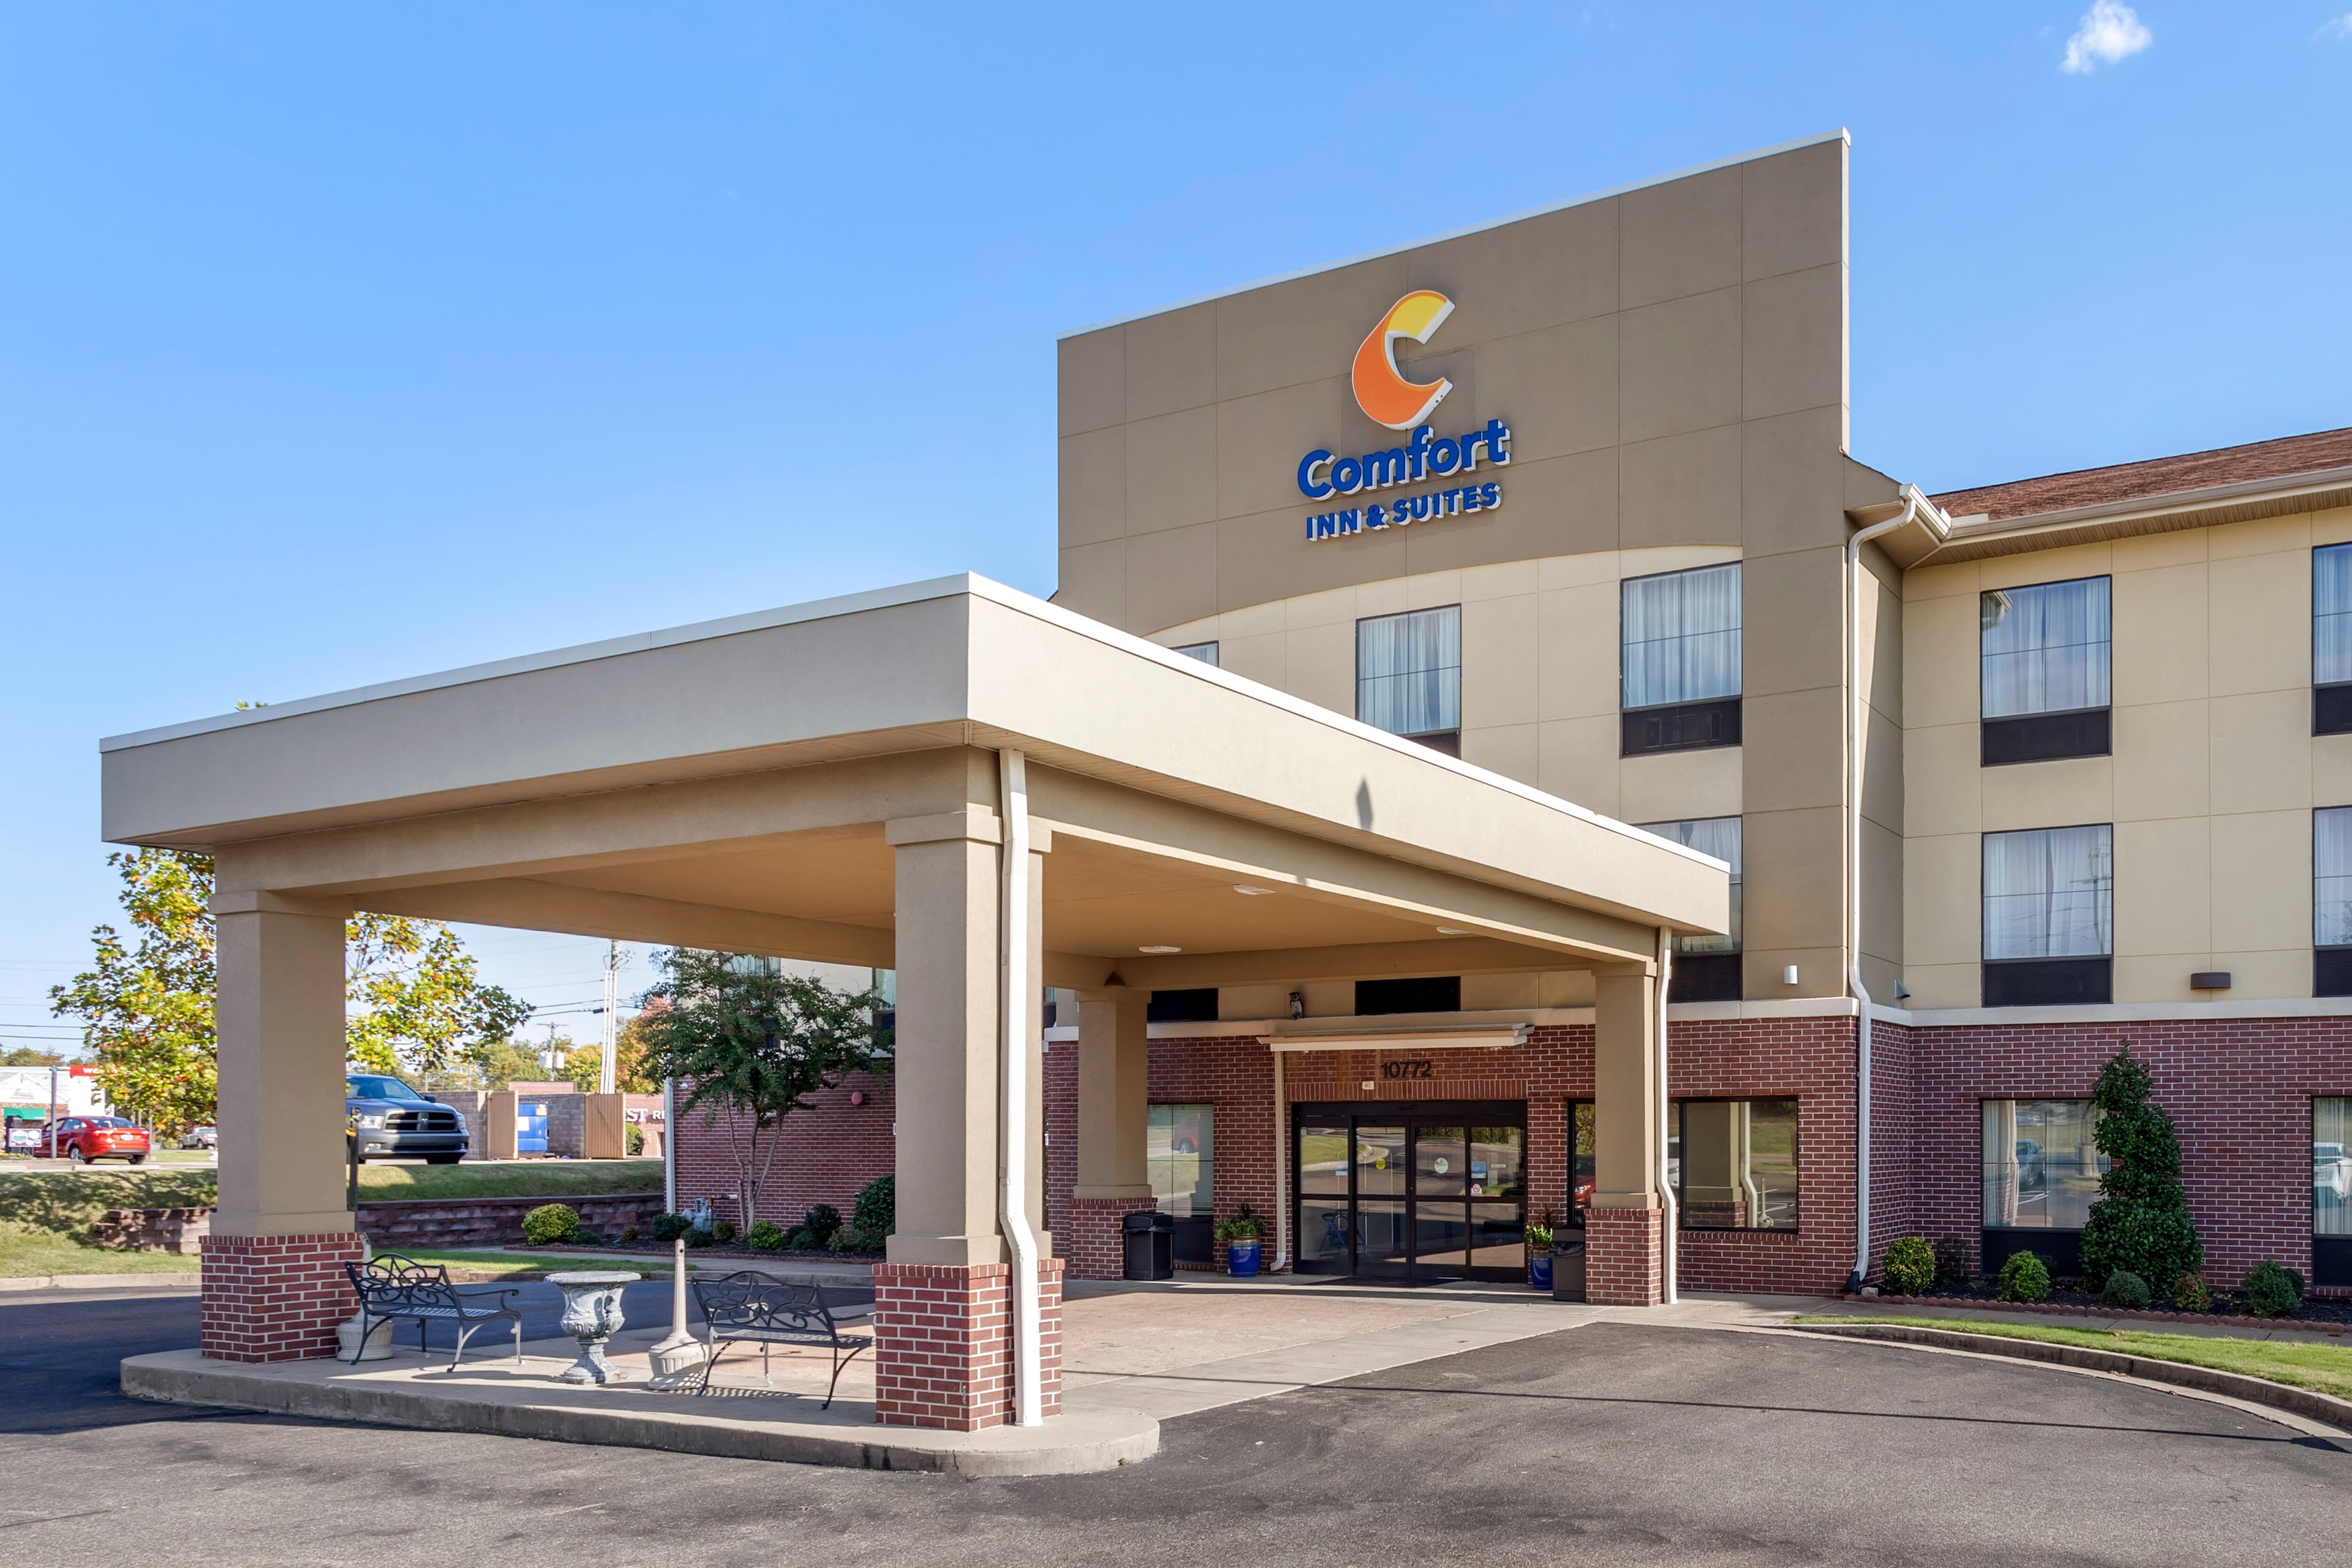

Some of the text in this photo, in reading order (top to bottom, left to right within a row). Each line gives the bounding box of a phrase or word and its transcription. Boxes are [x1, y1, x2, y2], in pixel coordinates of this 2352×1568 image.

[1297, 419, 1510, 501] Comfort
[1306, 483, 1501, 541] INN & SUITES
[1381, 1060, 1431, 1078] 10772
[624, 1107, 648, 1122] ST
